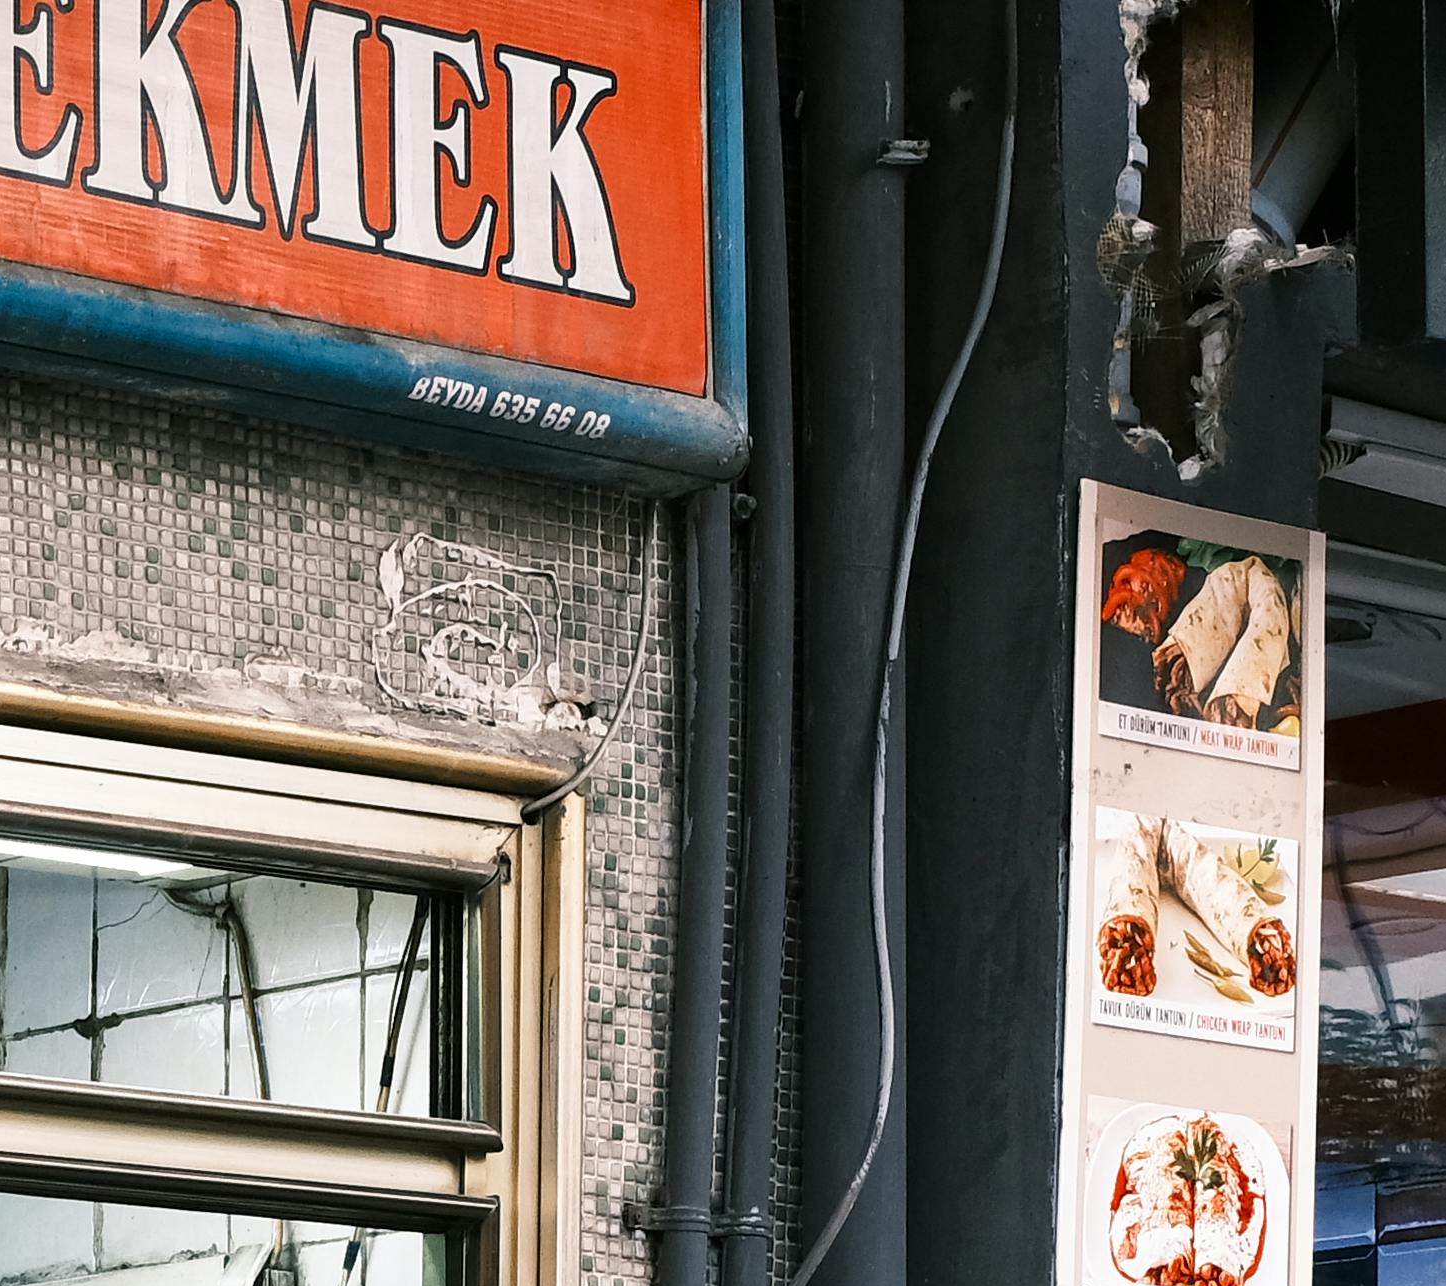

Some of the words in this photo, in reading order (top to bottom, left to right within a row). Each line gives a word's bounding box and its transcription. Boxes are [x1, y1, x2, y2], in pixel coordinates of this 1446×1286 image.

[408, 376, 488, 413] BEYDA
[489, 391, 541, 424] 635
[539, 402, 576, 432] 66
[574, 411, 611, 439] 08
[1118, 713, 1127, 730] ET
[1130, 714, 1156, 735] DÜRÜM
[1200, 730, 1220, 746] MEAT
[1223, 736, 1243, 750] WRAP
[1246, 738, 1278, 757] TANTUNI
[1099, 999, 1122, 1017] TAVUK
[1125, 1001, 1151, 1021] DÜRÜM
[1196, 1014, 1228, 1032] CHICKEN
[1232, 1021, 1251, 1036] WRAP
[1254, 1023, 1286, 1041] TANTUNI
